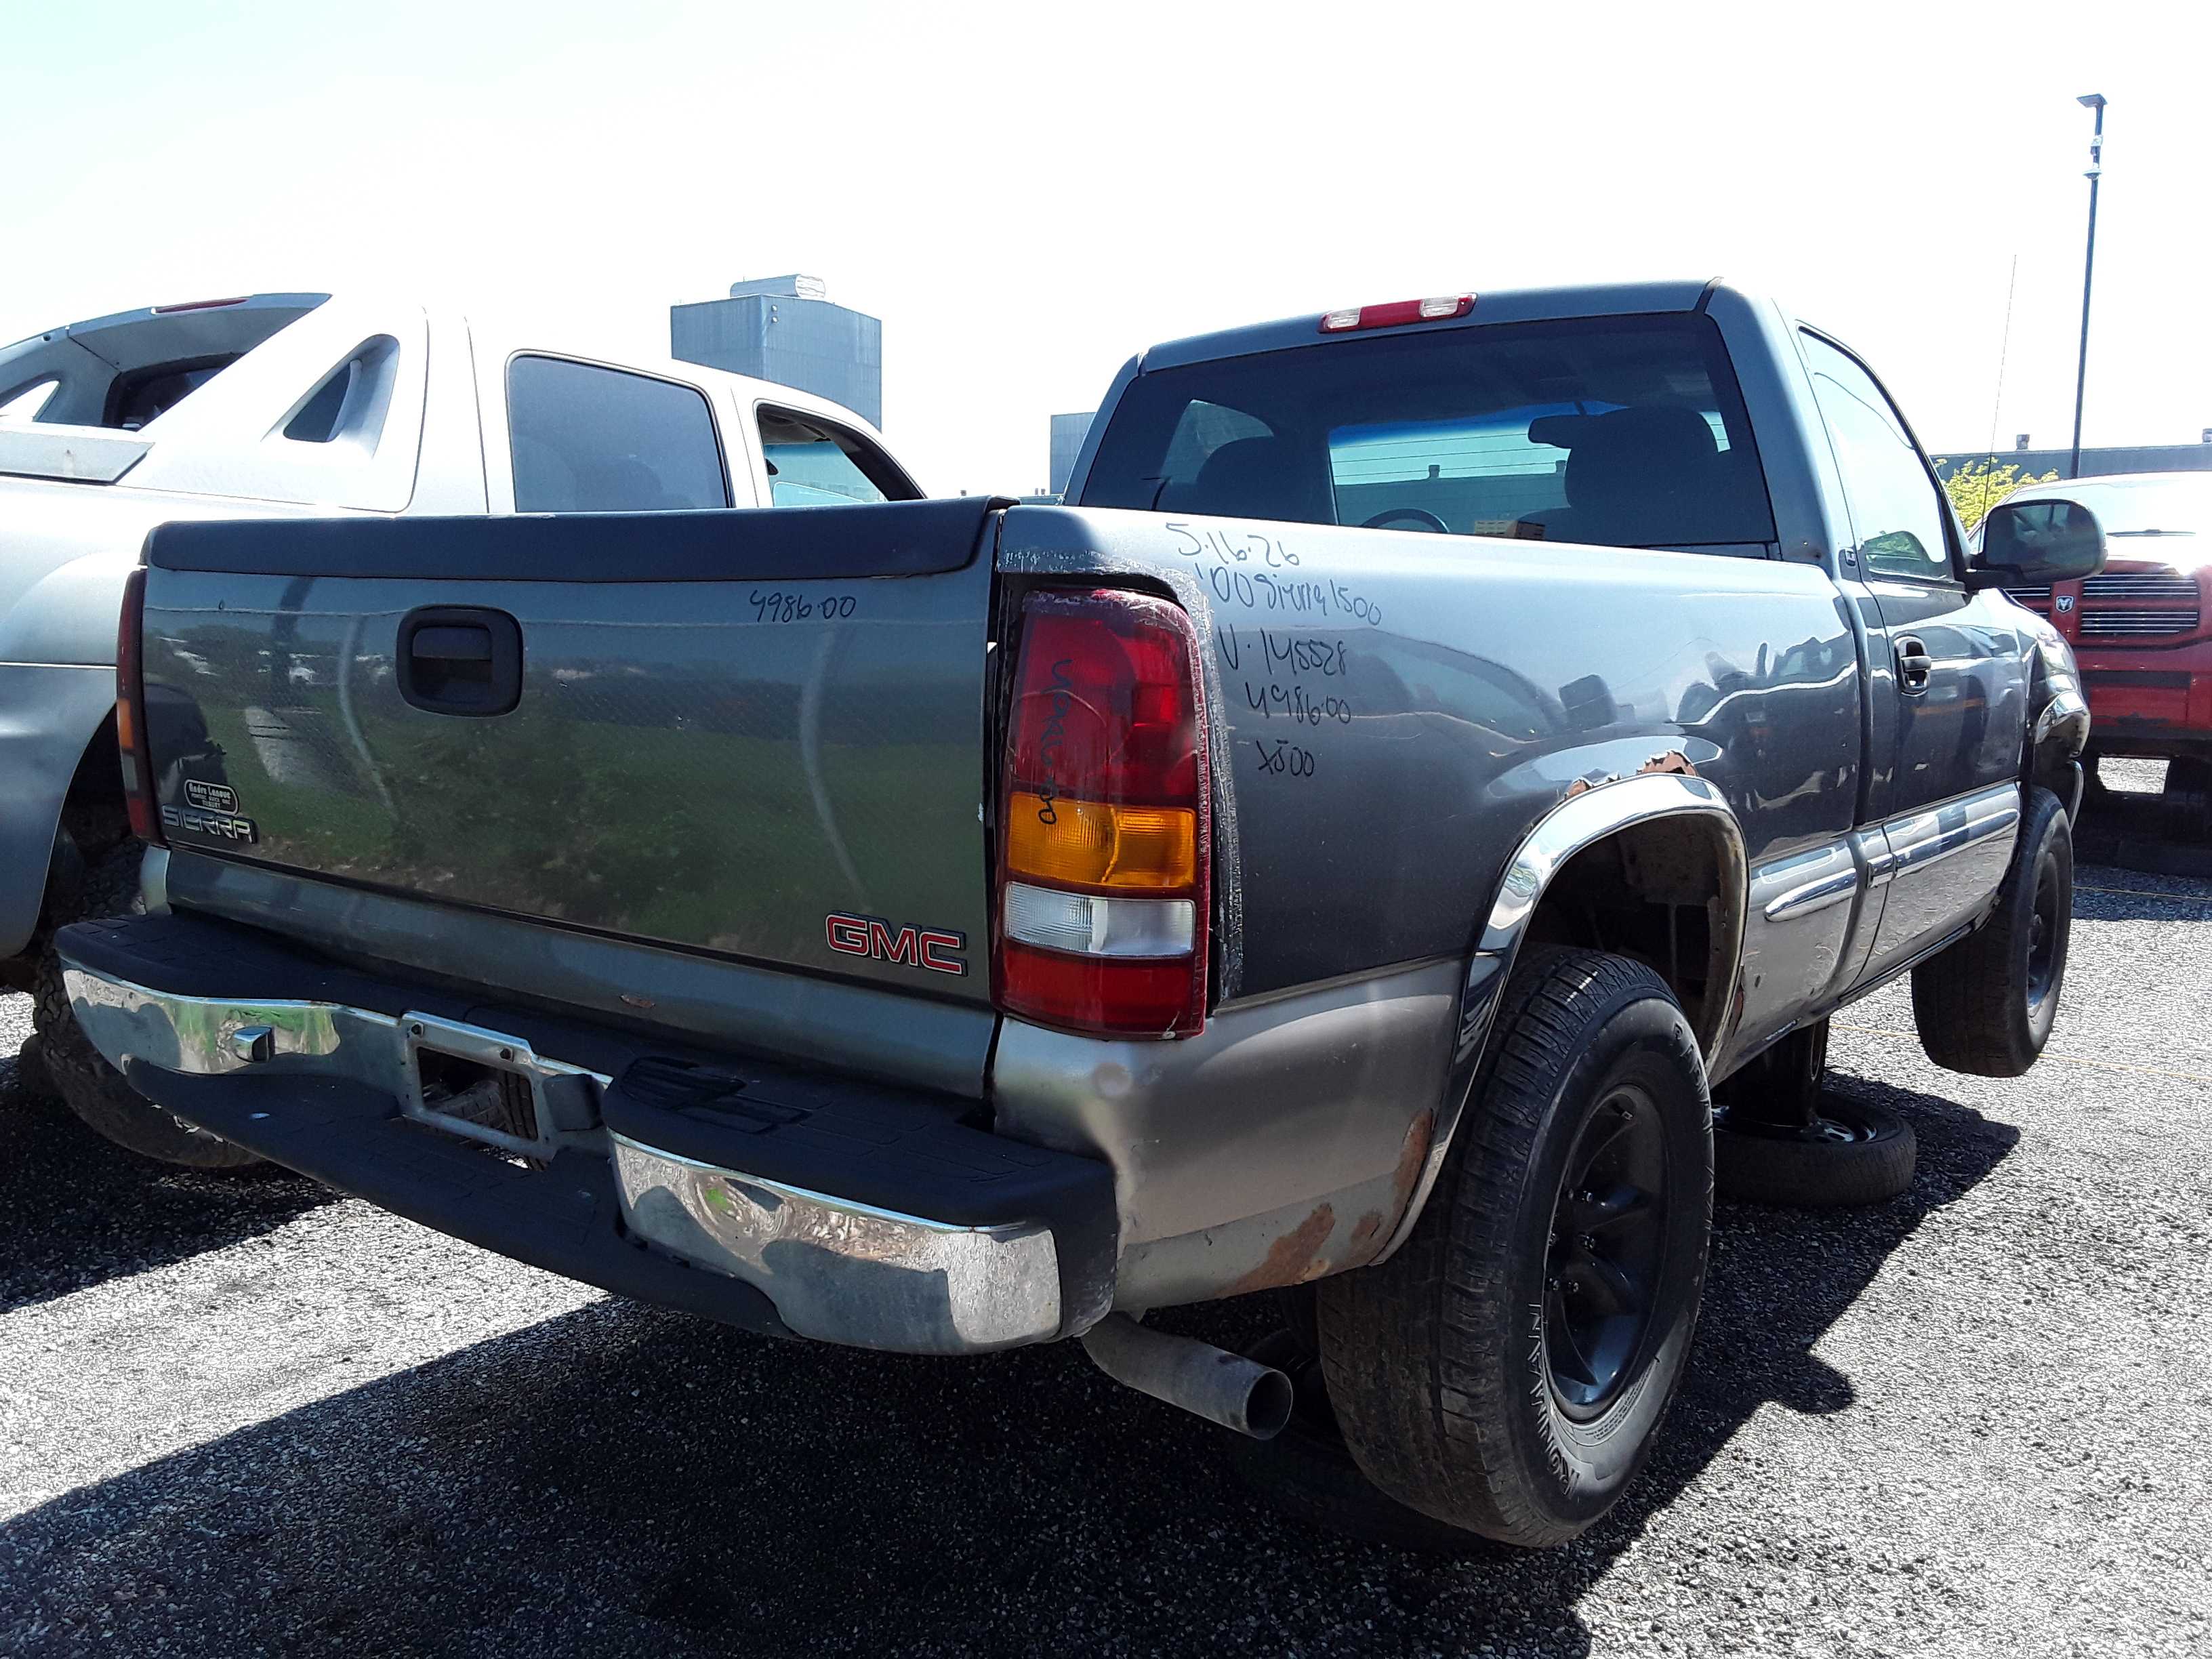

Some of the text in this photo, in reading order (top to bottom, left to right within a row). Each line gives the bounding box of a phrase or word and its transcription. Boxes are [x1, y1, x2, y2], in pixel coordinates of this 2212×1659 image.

[1330, 579, 1382, 626] 1500
[162, 804, 255, 844] SIERRA
[825, 912, 965, 976] GMC
